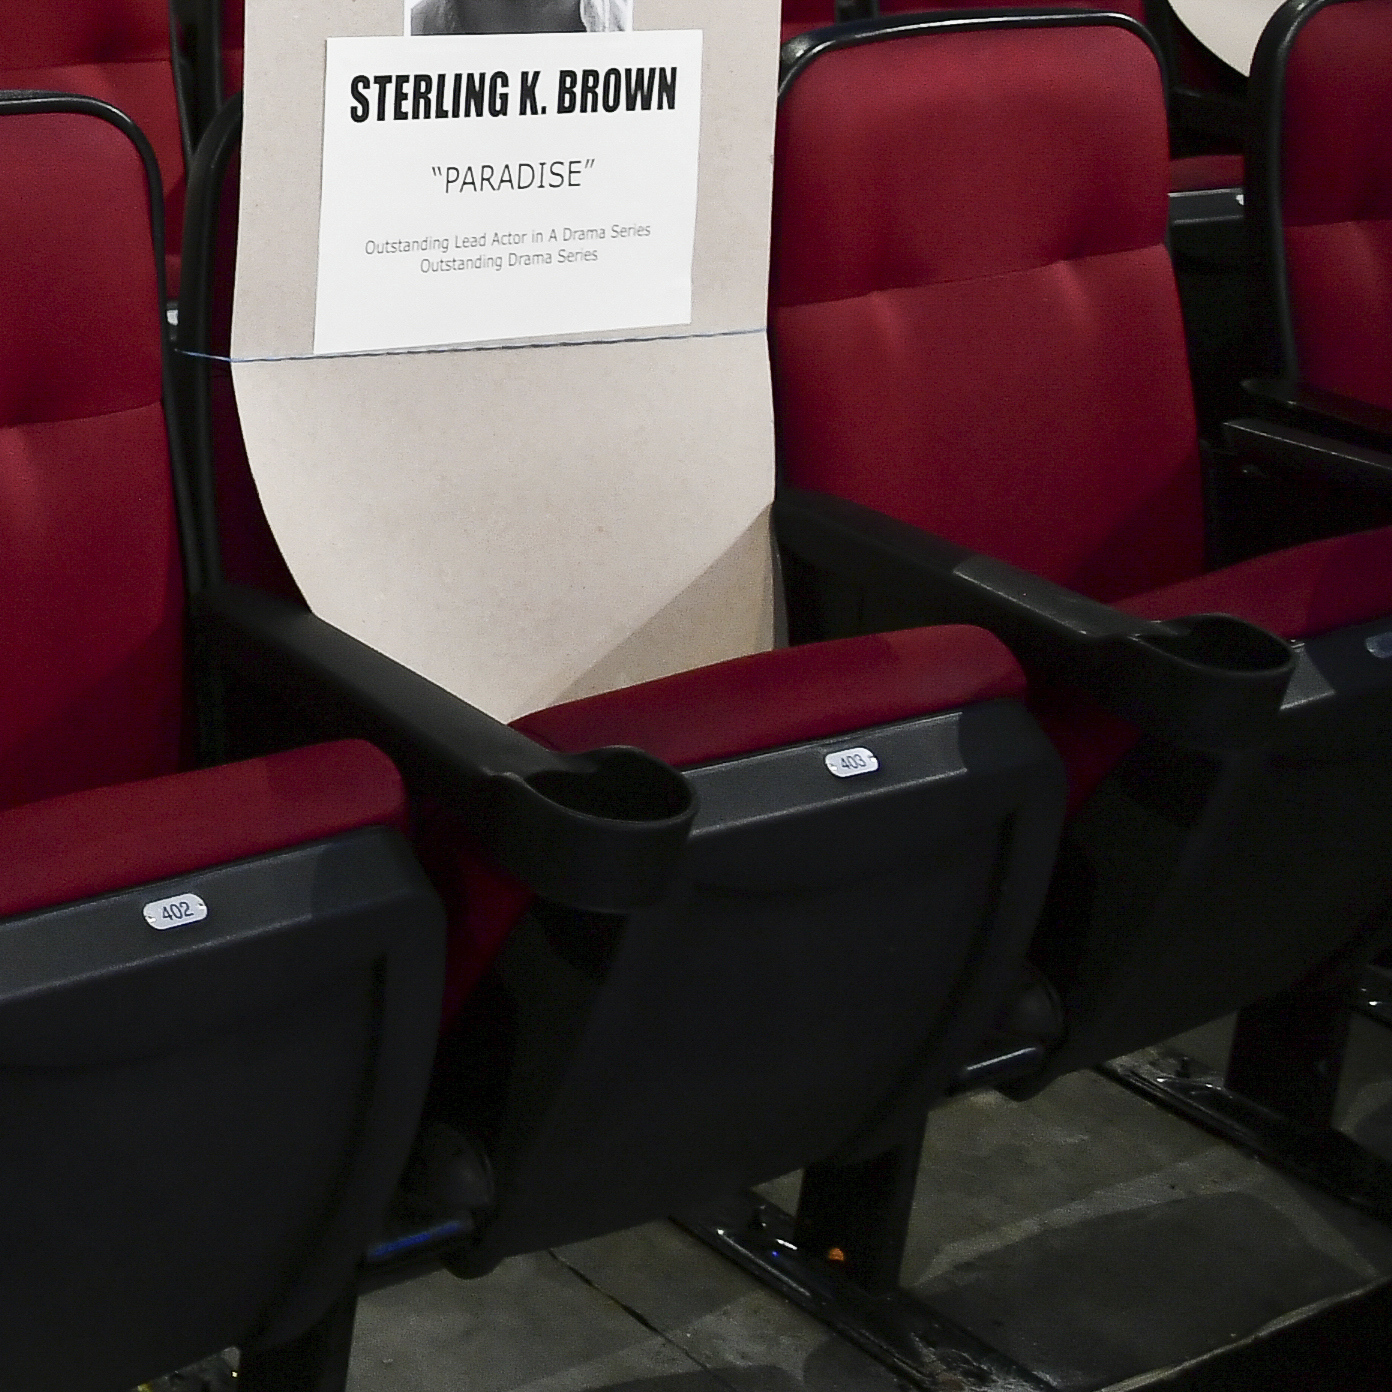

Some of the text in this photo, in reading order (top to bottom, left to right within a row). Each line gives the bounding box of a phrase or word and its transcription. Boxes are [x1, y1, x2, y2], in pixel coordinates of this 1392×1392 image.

[350, 67, 677, 123] STERLING K. BROWN
[431, 158, 595, 194] “PARADISE”
[365, 223, 651, 255] Outstanding Lead Actor in A Drama Series
[420, 248, 598, 273] Outstanding Drama Series
[841, 754, 867, 769] 403
[163, 901, 194, 920] 402
